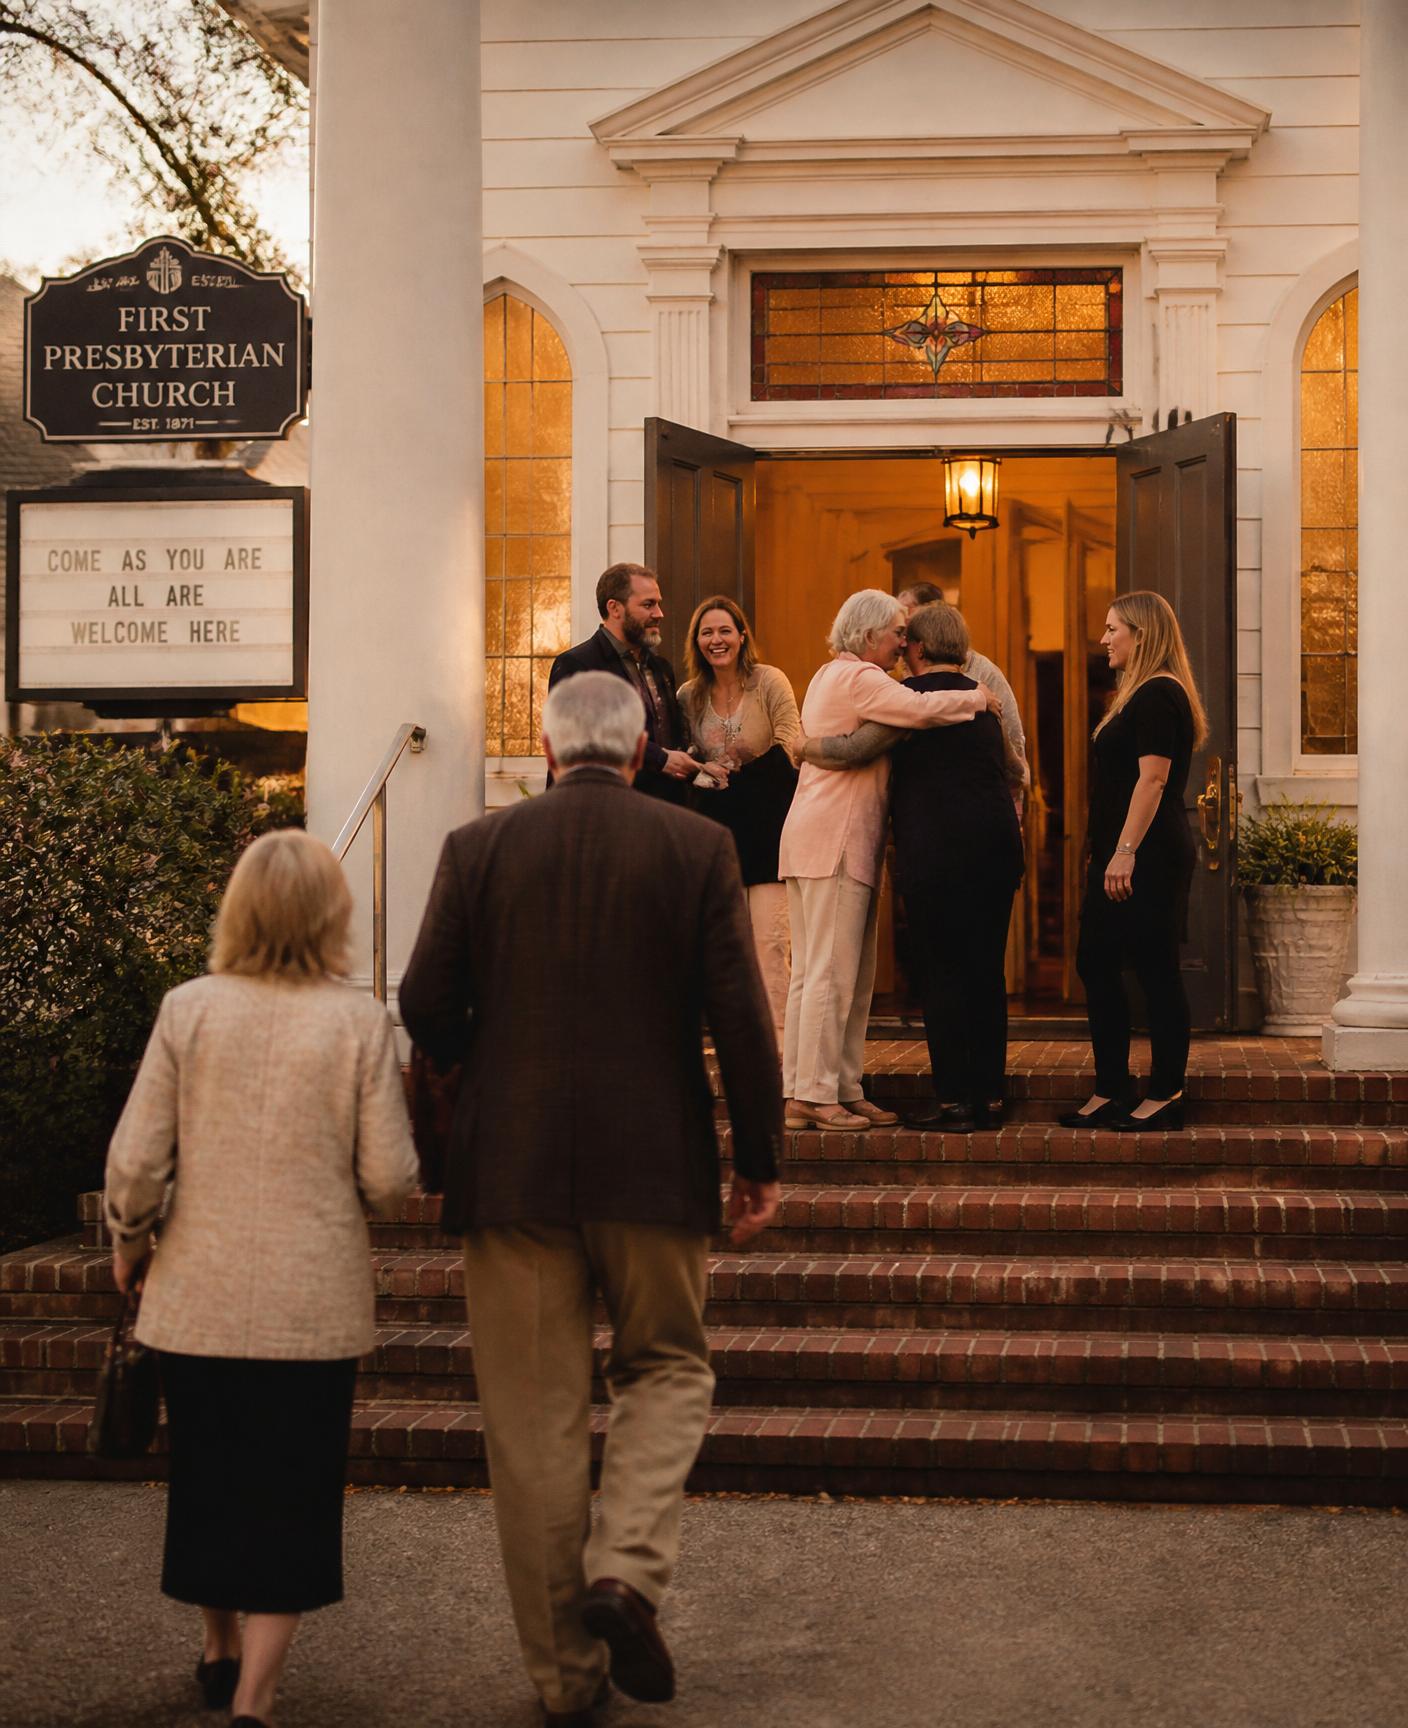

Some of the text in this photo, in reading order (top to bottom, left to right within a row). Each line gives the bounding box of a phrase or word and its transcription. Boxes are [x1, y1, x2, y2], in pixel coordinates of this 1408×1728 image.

[118, 306, 212, 333] FIRST
[43, 342, 286, 371] PRESBYTERIAN
[91, 381, 237, 408] CHURCH
[48, 547, 263, 572] COME AS YOU ARE
[108, 584, 205, 608] ALL ARE
[71, 620, 241, 644] WELCOME HERE
